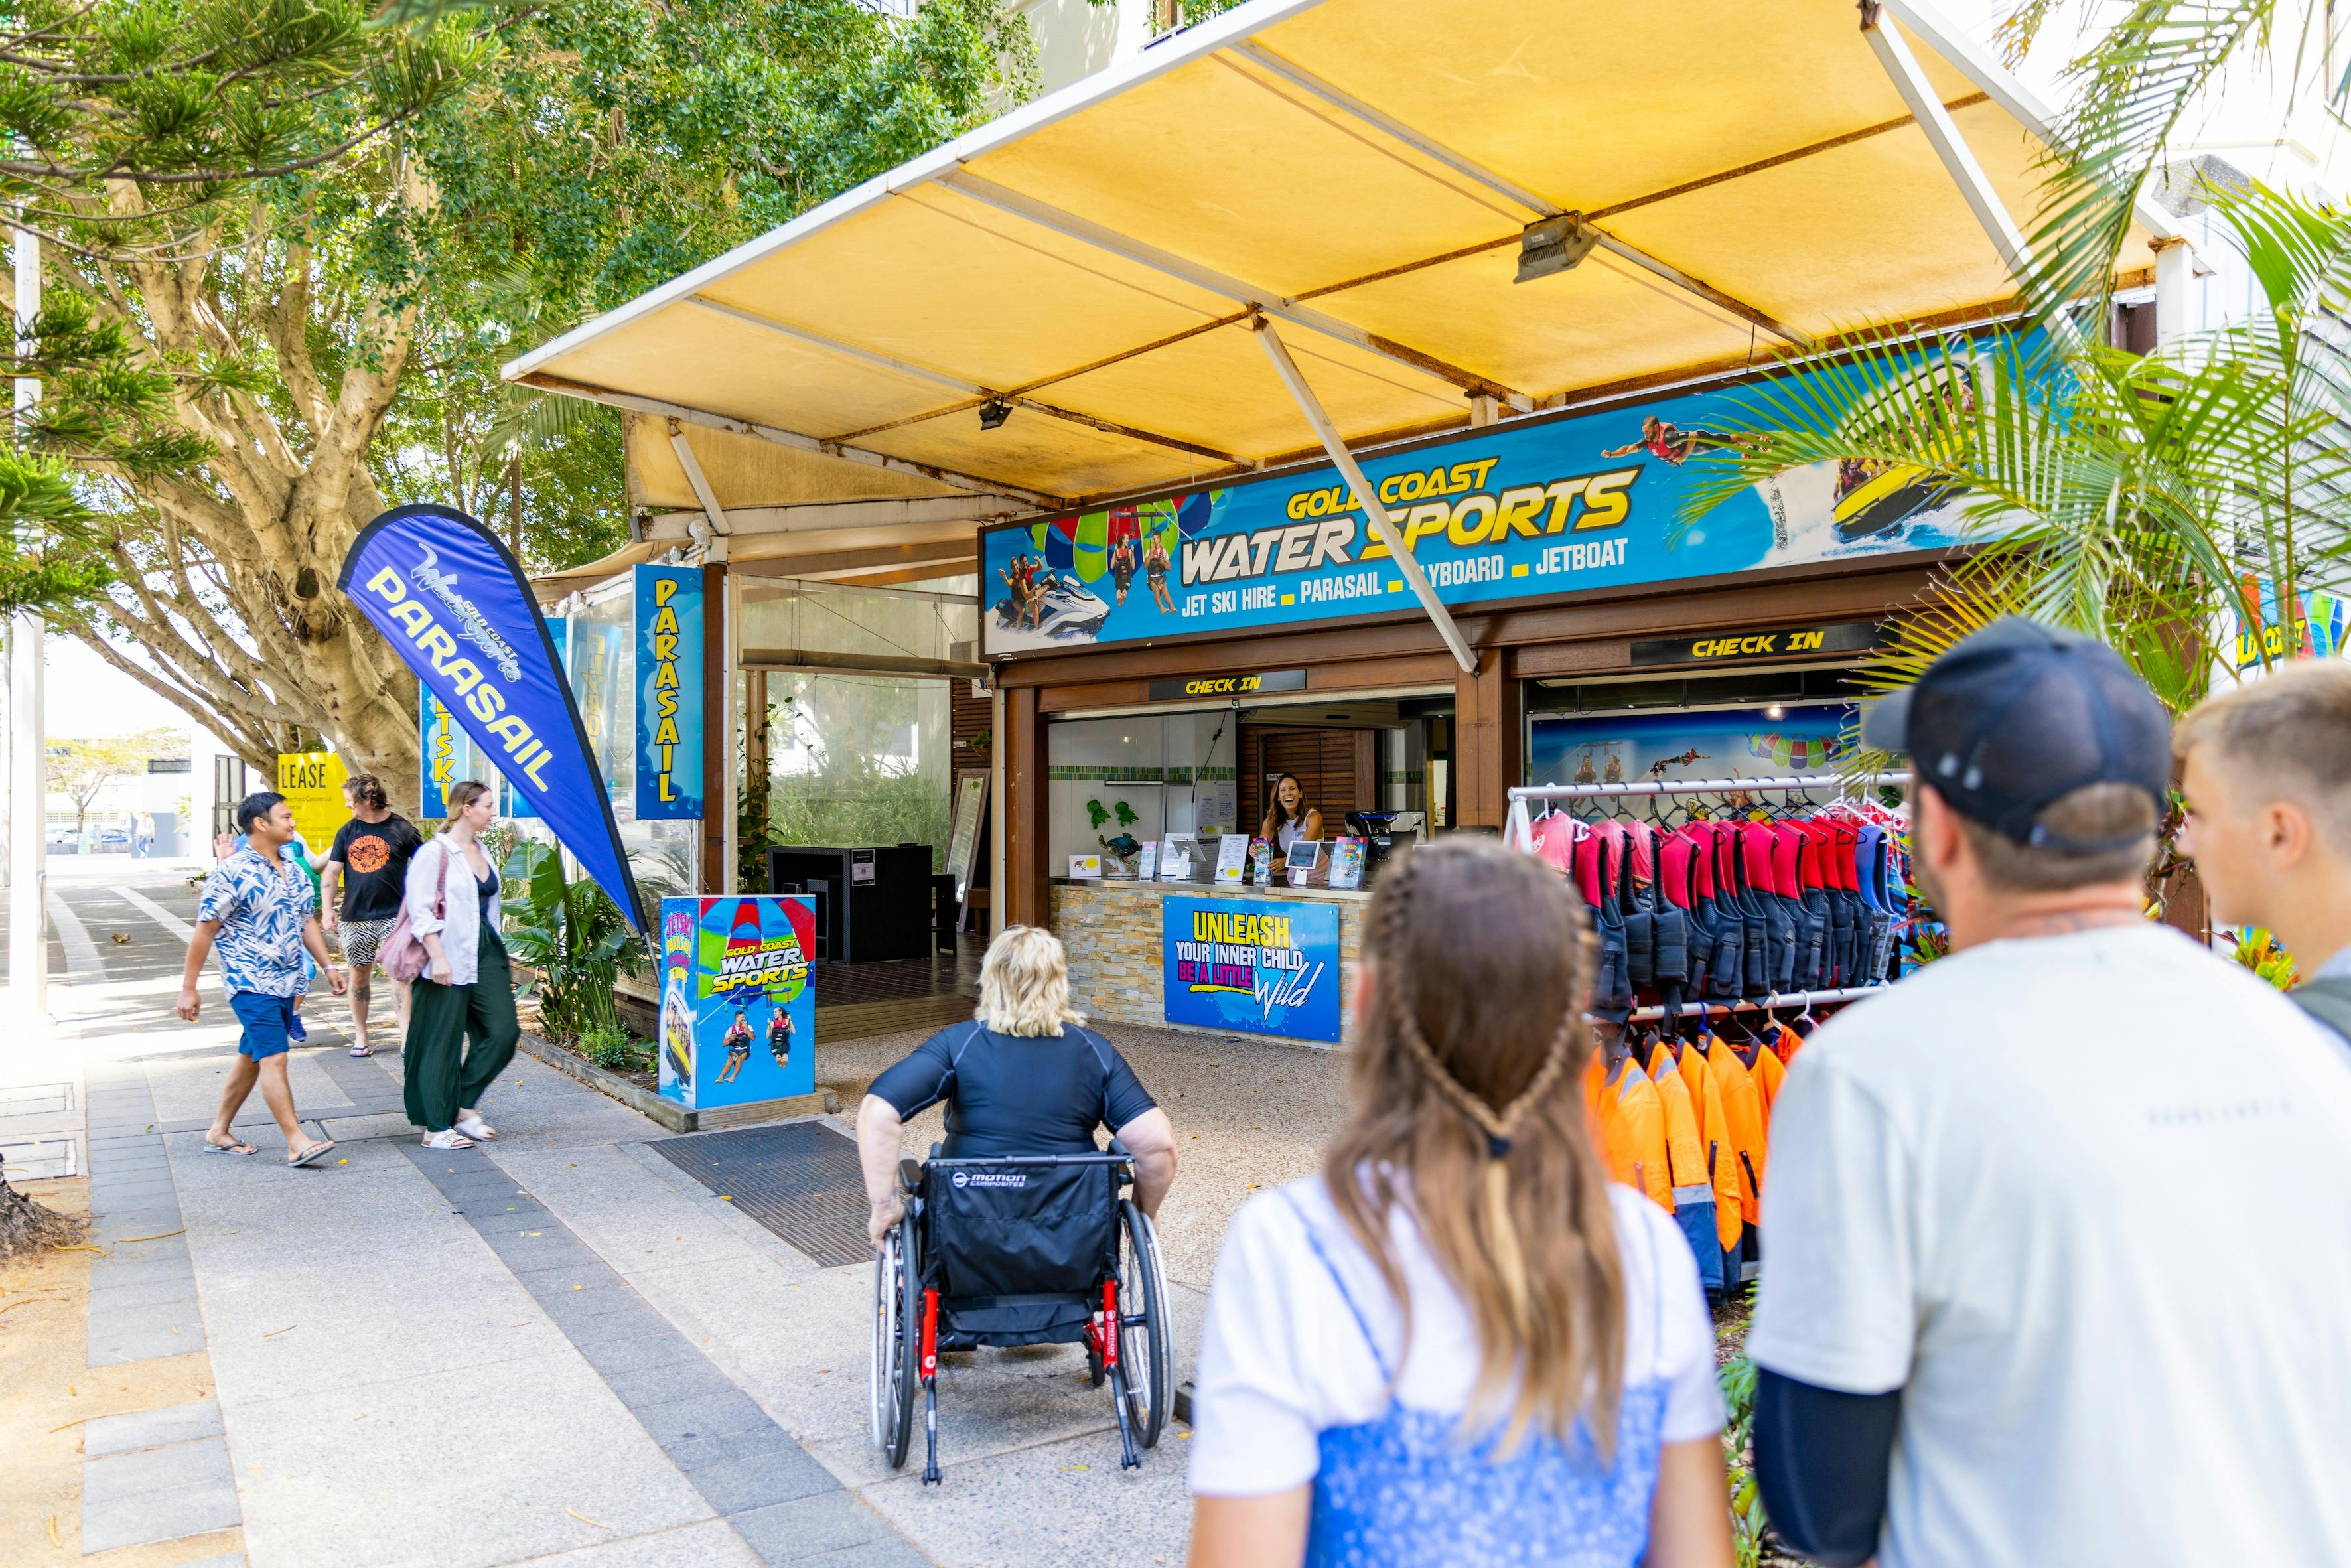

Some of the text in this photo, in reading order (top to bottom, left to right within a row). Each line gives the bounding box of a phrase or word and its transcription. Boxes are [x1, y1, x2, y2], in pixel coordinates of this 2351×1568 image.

[1379, 457, 1500, 504] COAST
[1181, 468, 1640, 587] WATER SPORTS
[1182, 537, 1628, 617] JET SKI HIRE PARASAIL YBOARD JETBOAT
[1691, 631, 1825, 657] CHECK IN
[366, 565, 553, 793] PARASAIL
[654, 579, 681, 802] PARASAIL
[1186, 676, 1262, 695] CHECK IN
[433, 698, 456, 805] TSKI
[281, 764, 326, 789] LEASE
[725, 938, 798, 958] GOLD COAST
[1193, 911, 1290, 948] UNLEASH
[721, 947, 801, 975] WATER
[1175, 940, 1304, 971] YOUR INNER CHILD
[711, 962, 810, 993] SPORTS
[1178, 960, 1326, 1023] BE A LITTLE Wild
